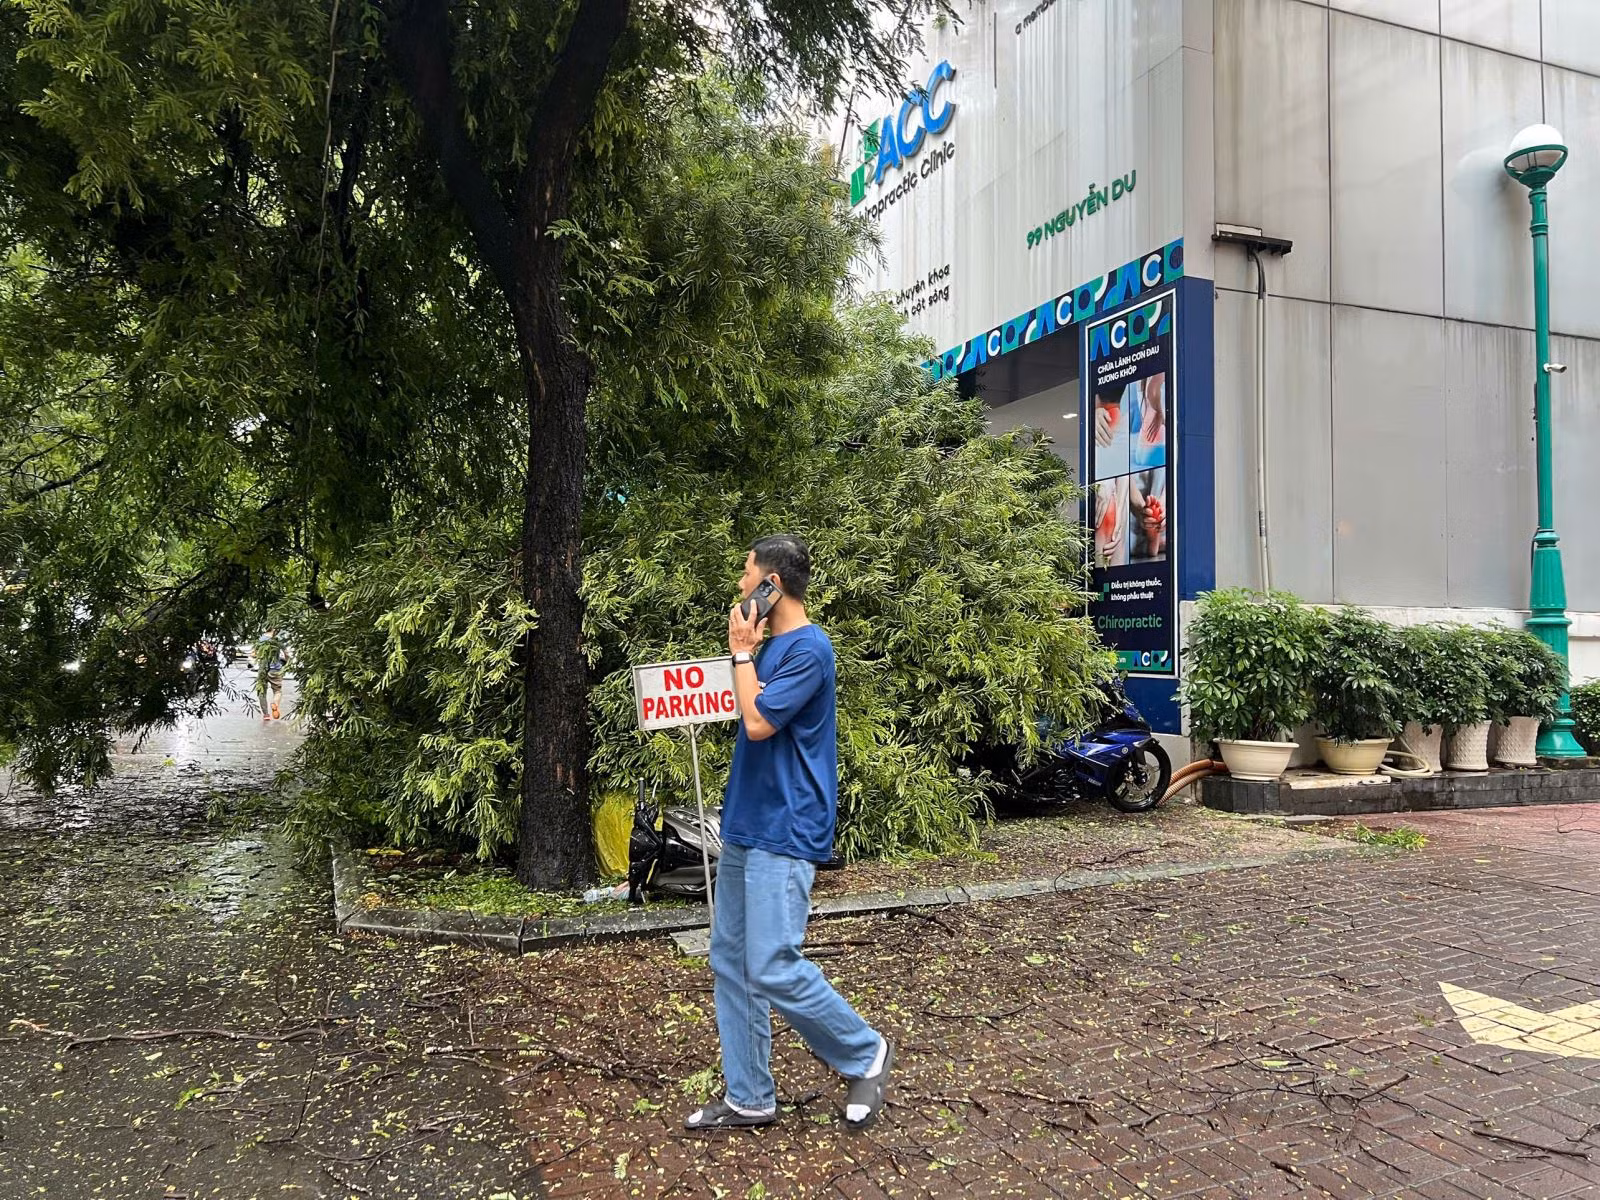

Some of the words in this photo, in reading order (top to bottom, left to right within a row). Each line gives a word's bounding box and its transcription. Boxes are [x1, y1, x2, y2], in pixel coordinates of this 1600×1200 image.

[875, 59, 957, 186] ACC
[920, 141, 955, 179] Clinic
[1026, 226, 1043, 250] 99
[1112, 169, 1136, 201] DU
[928, 264, 950, 286] khoa
[1146, 345, 1160, 357] ĐAU
[1097, 613, 1162, 632] Chiropractic
[663, 665, 704, 691] NO
[642, 689, 735, 720] PARKING
